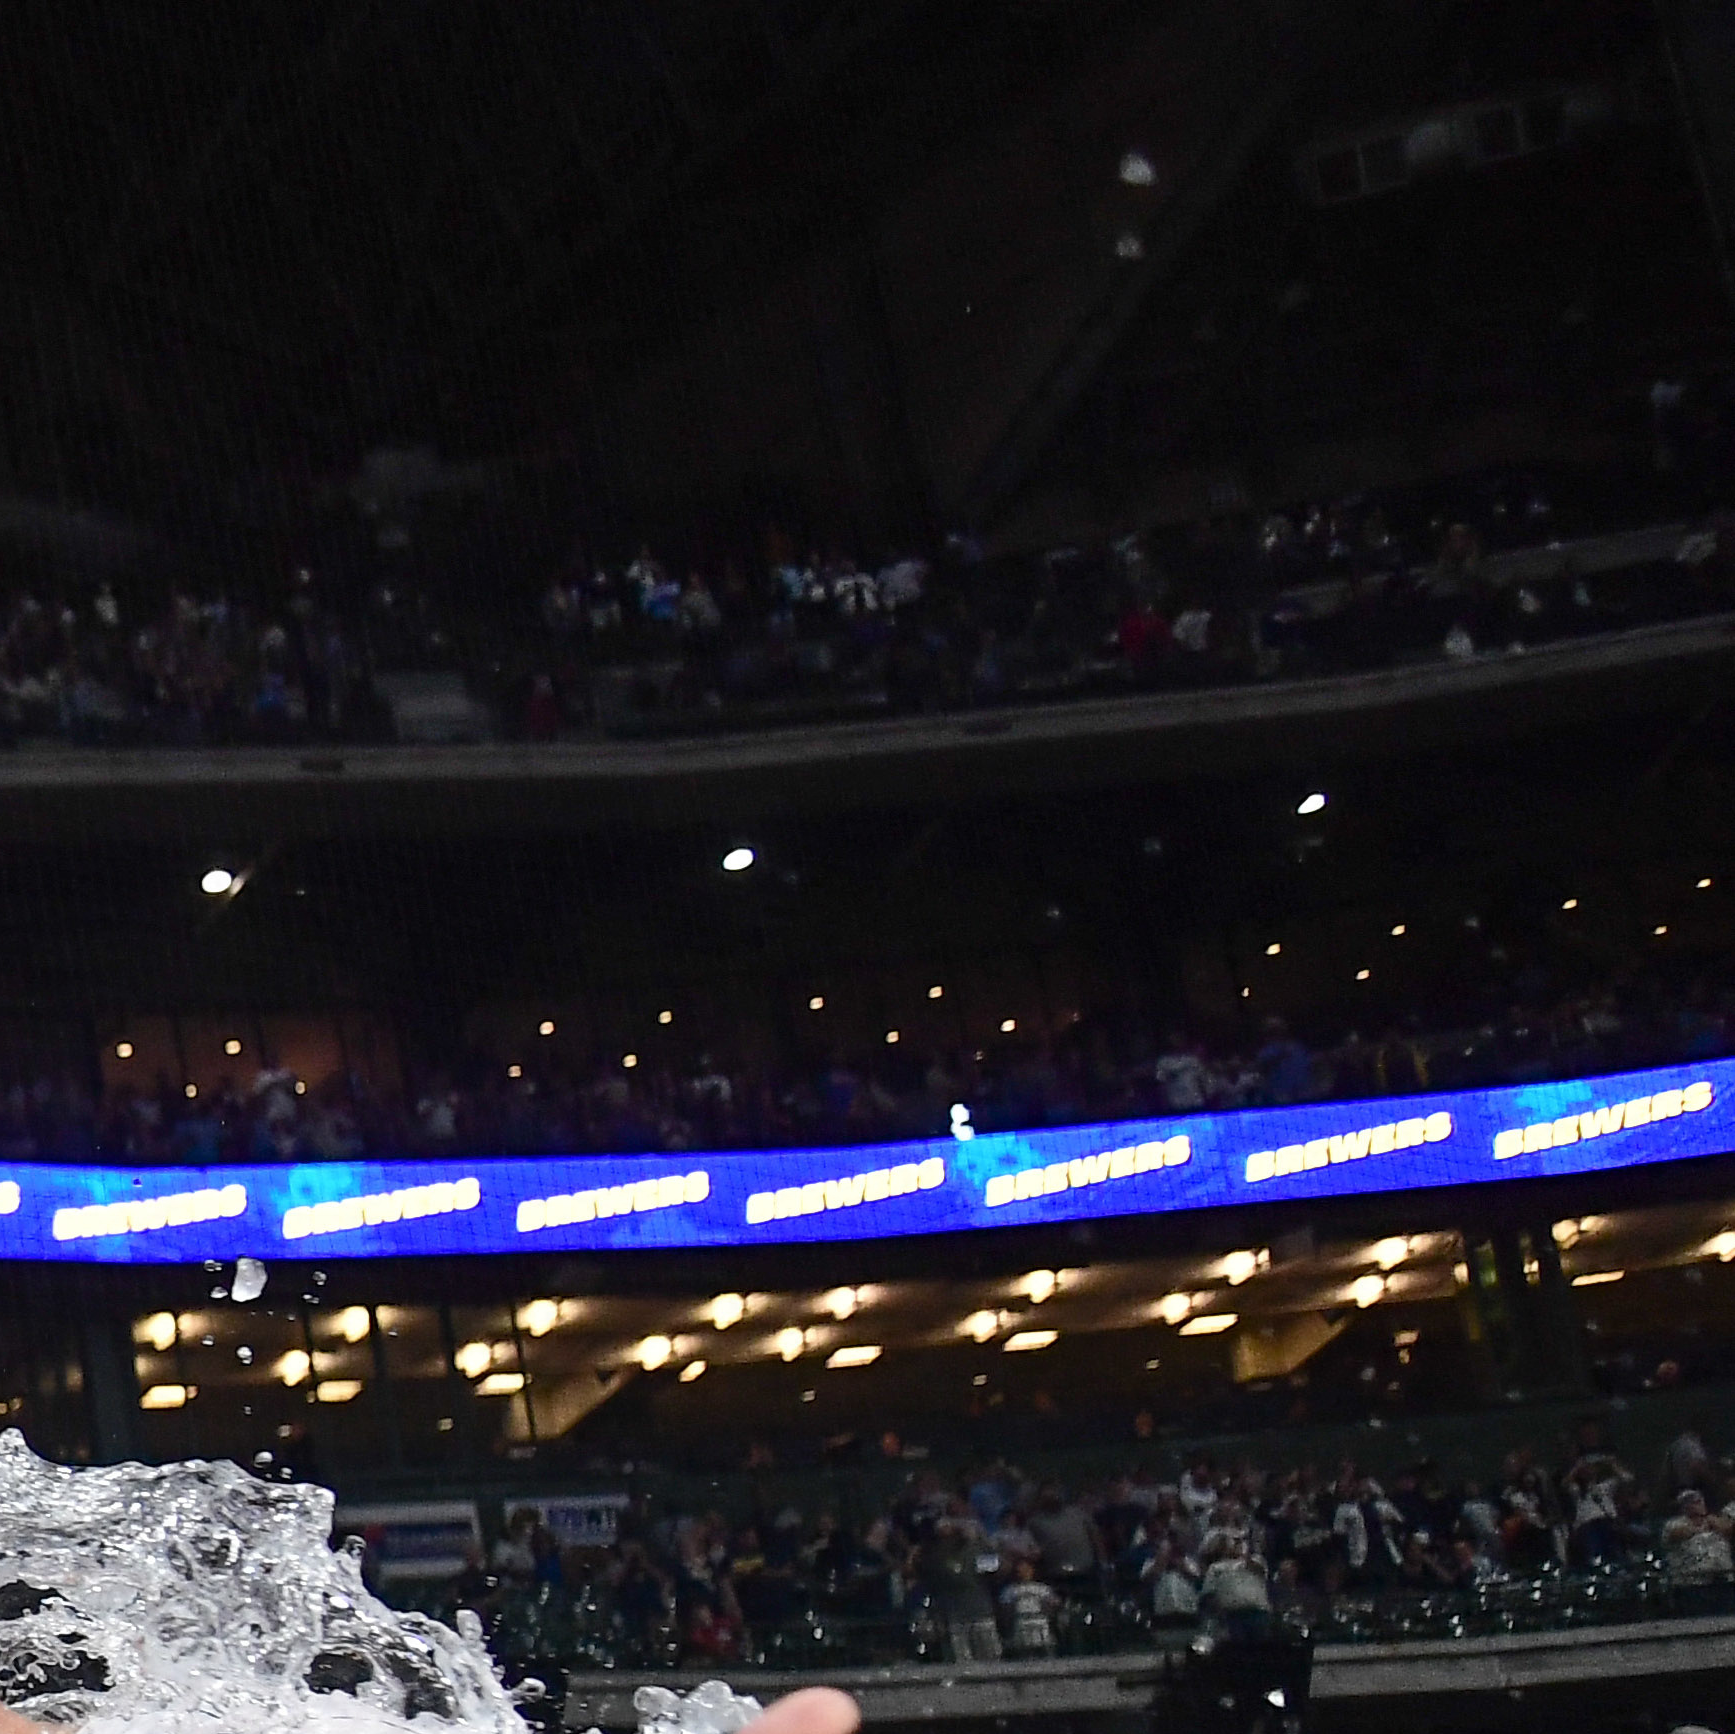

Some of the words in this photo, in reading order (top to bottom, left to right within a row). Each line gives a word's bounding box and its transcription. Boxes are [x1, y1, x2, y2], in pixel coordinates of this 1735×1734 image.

[1245, 1112, 1454, 1183] BREWERS
[1493, 1081, 1715, 1160] BREWERS
[516, 1171, 709, 1232] BREWERS
[746, 1157, 943, 1224] BREWERS
[985, 1135, 1191, 1206] BREWERS
[53, 1184, 247, 1240] BREWERS
[282, 1177, 480, 1239] BREWERS
